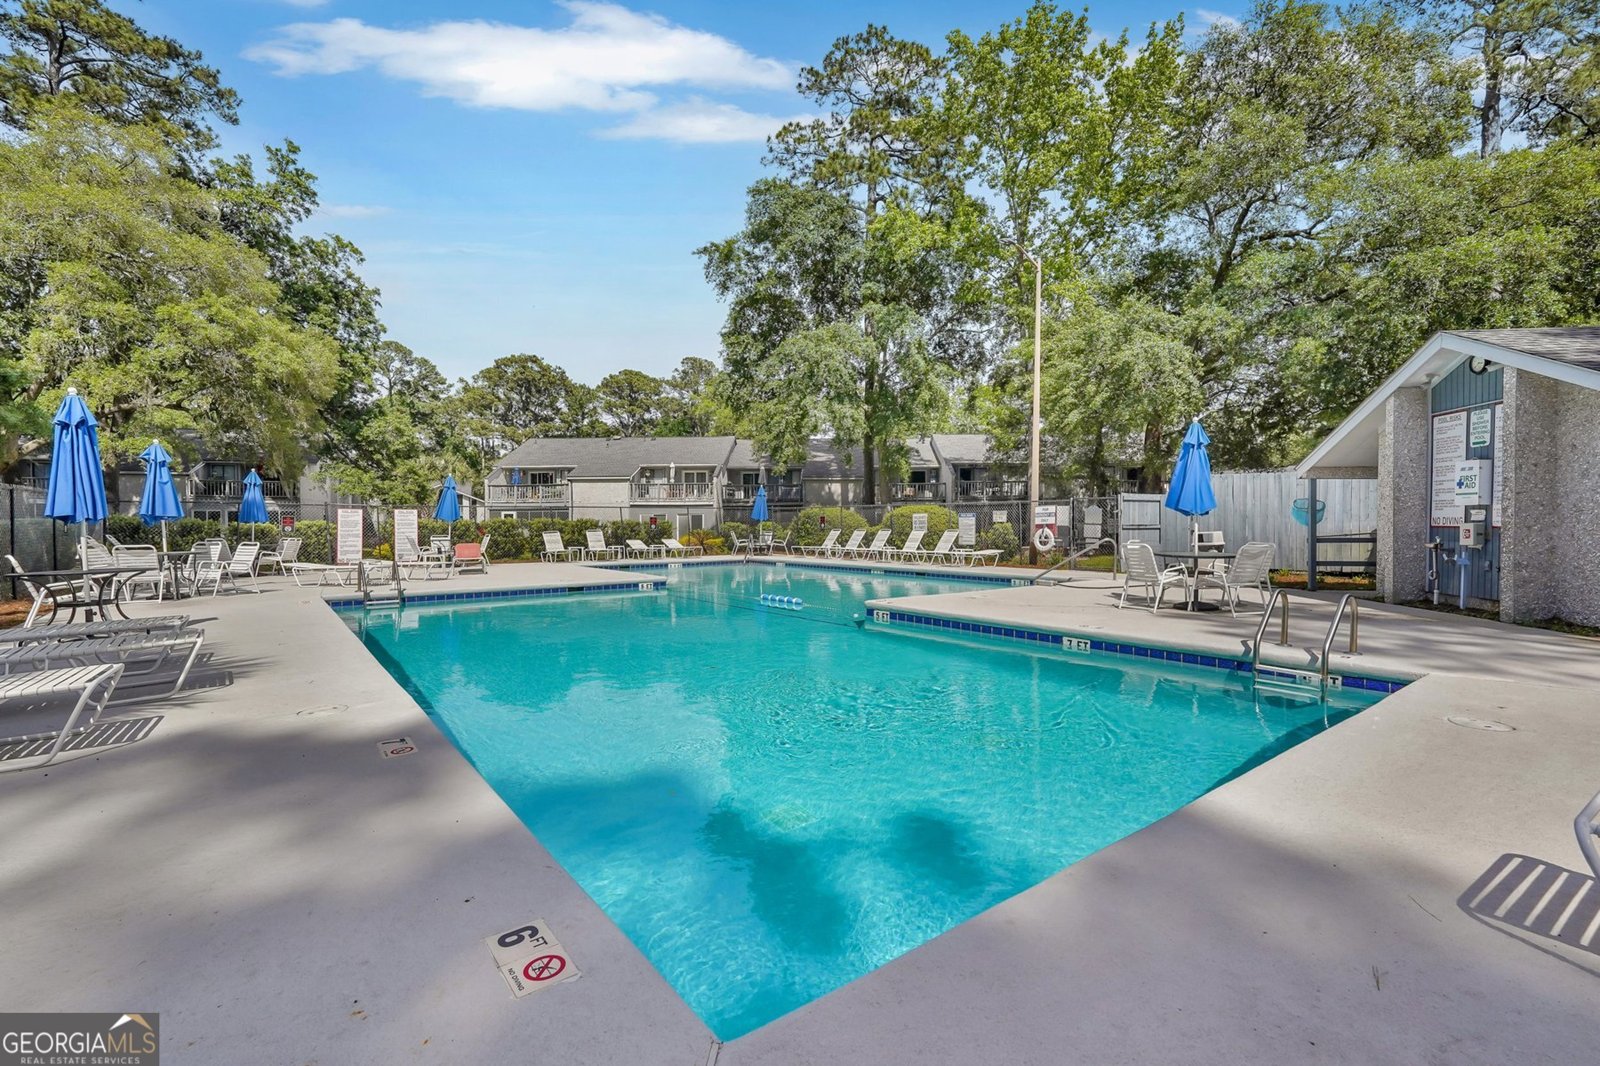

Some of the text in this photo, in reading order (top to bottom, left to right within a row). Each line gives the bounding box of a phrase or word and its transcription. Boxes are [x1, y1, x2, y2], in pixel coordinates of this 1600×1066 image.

[1432, 517, 1440, 526] NO
[1066, 639, 1073, 649] 7
[497, 925, 548, 948] 6 FT
[508, 967, 525, 992] NO DIVING
